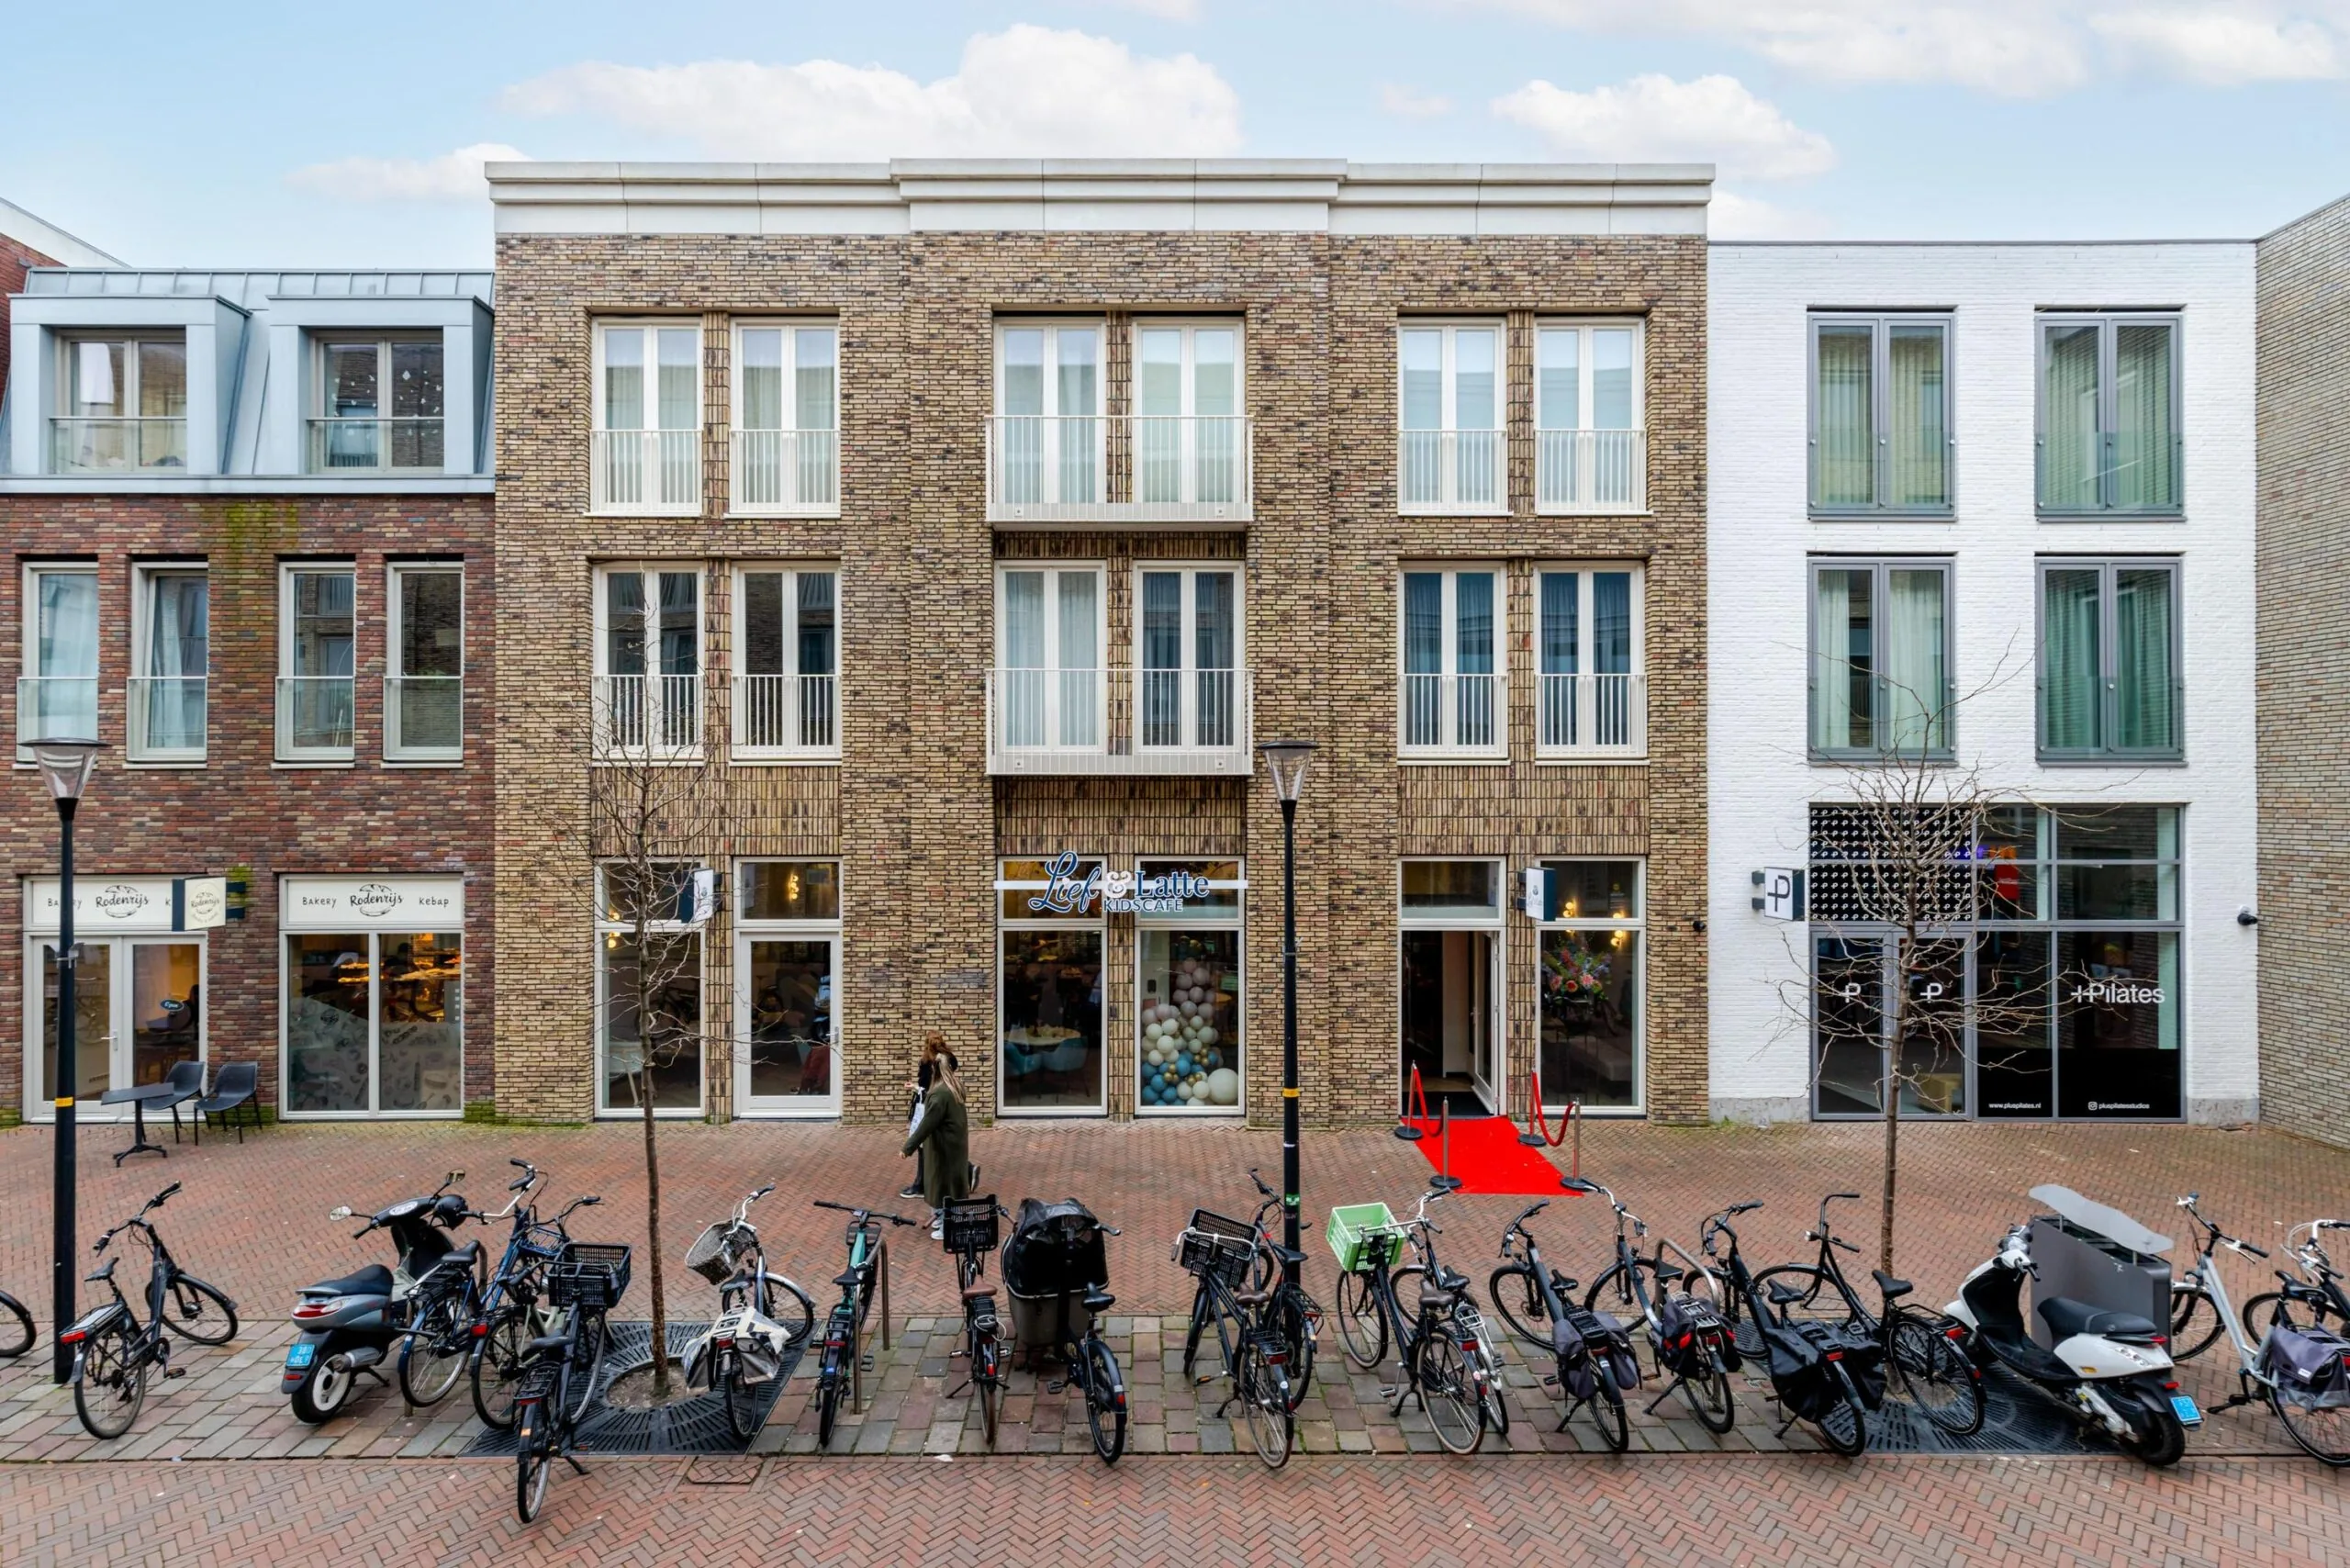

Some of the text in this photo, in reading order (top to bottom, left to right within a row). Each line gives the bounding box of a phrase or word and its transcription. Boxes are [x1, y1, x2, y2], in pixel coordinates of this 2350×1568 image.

[1028, 851, 1210, 913] Lief & Latte
[95, 893, 150, 909] Rodenrijs
[350, 892, 404, 907] Rodenrijs
[1104, 899, 1183, 912] KIDSCAFE
